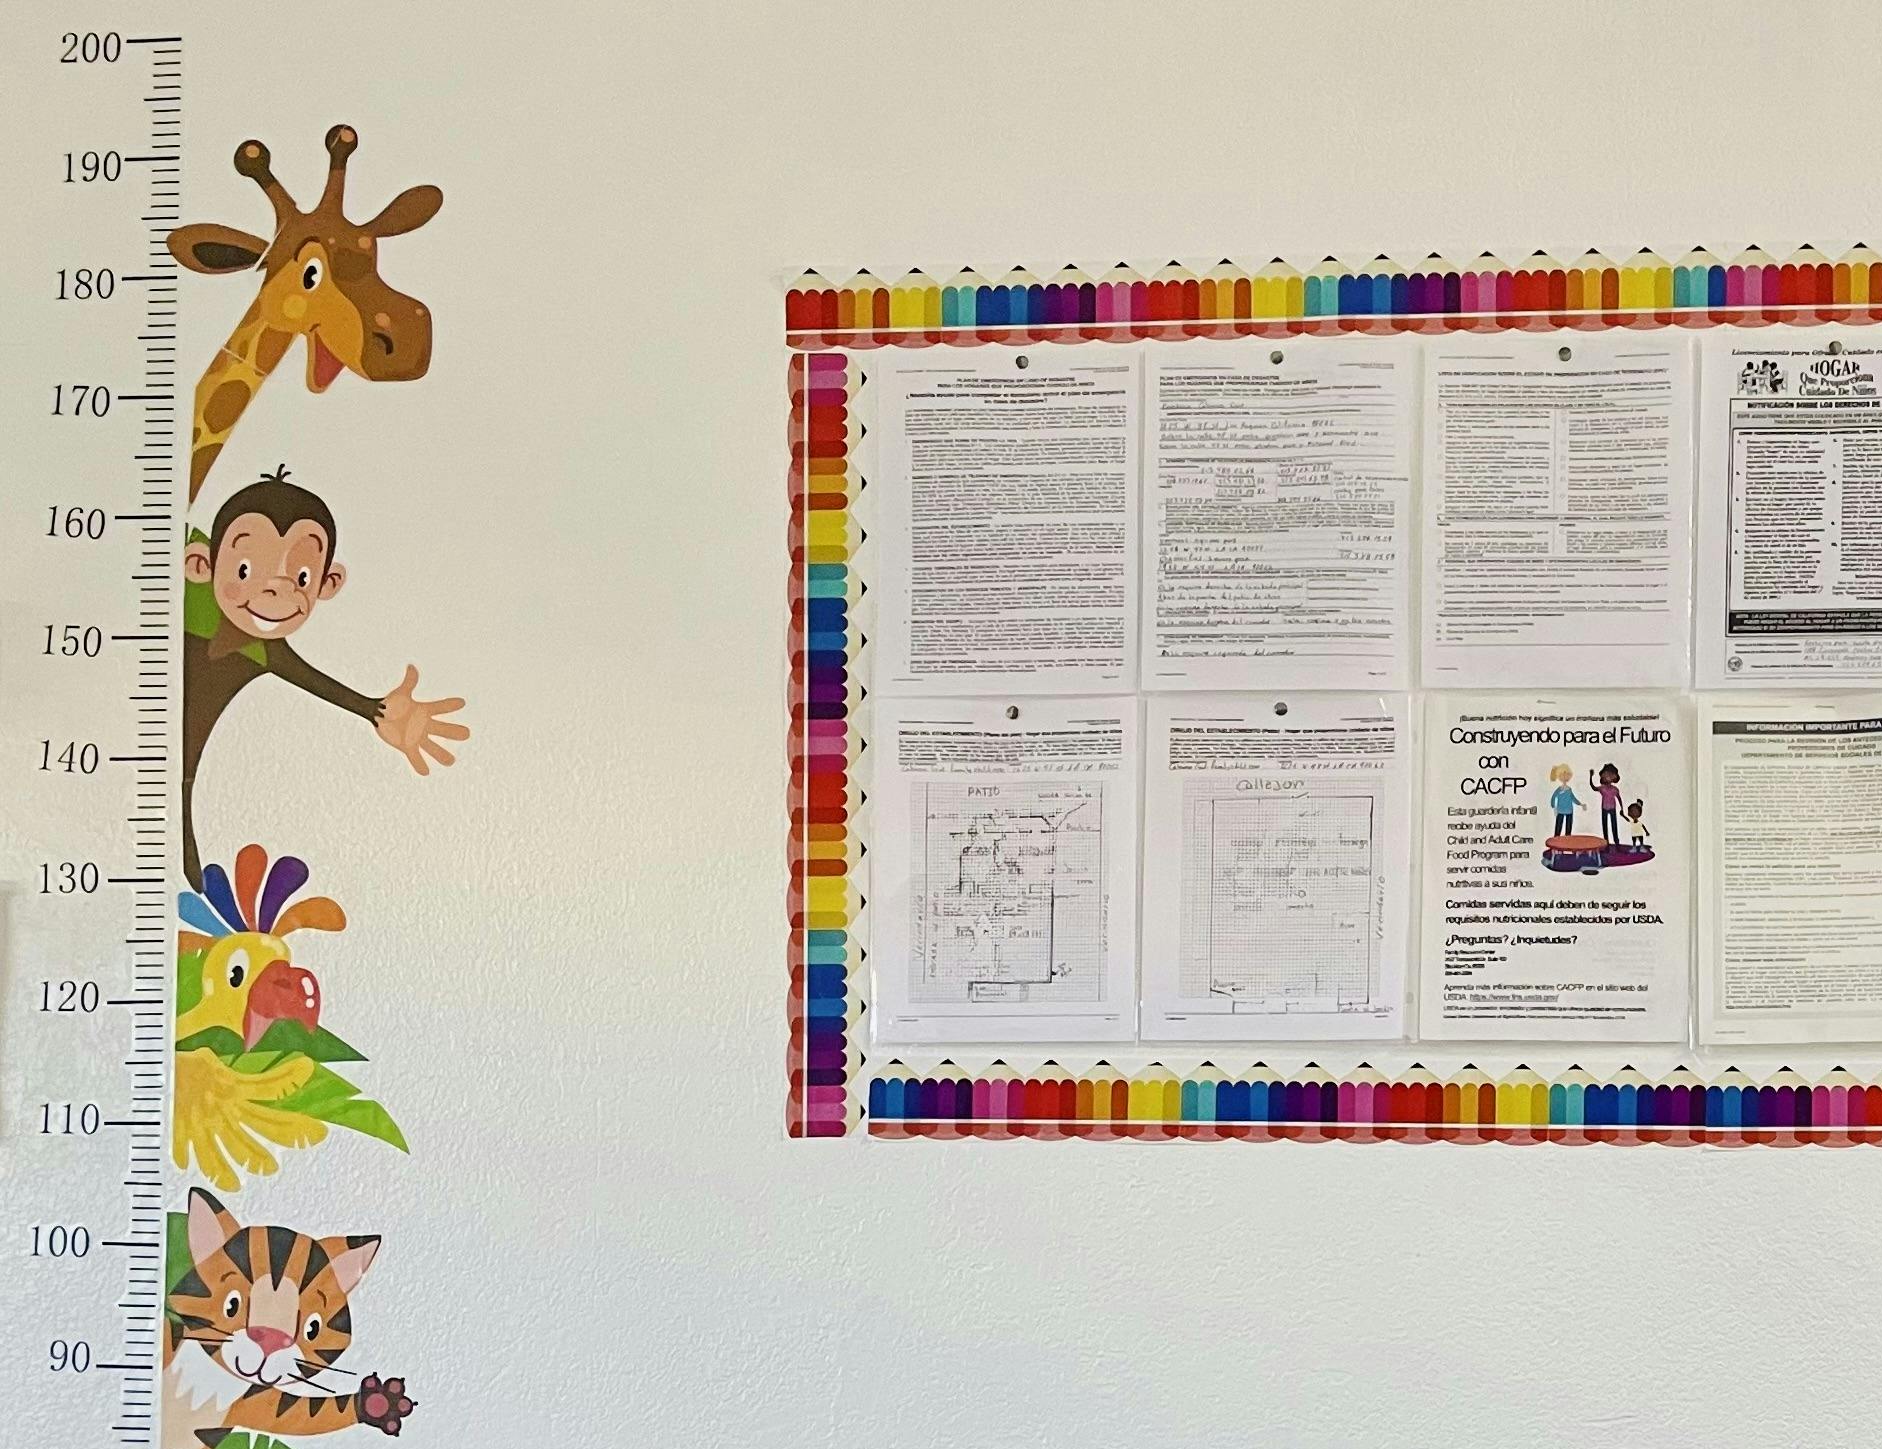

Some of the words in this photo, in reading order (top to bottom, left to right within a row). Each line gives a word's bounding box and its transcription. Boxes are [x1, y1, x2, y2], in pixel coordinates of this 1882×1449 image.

[60, 32, 121, 63] 200
[63, 151, 122, 183] 190
[56, 268, 115, 300] 180
[51, 384, 111, 417] 170
[46, 505, 106, 540] 160
[42, 624, 102, 658] 150
[1805, 721, 1858, 731] IMPORTANTE
[1860, 720, 1882, 730] PARA
[1450, 727, 1560, 747] Construyendo
[1563, 729, 1599, 747] para
[1602, 727, 1616, 743] el
[1620, 726, 1671, 744] Futuro
[38, 739, 99, 774] 140
[1479, 755, 1509, 769] con
[967, 786, 1000, 797] PATIO
[1460, 777, 1528, 795] CACFP
[1448, 807, 1467, 816] Esta
[1447, 822, 1473, 830] recibe
[1475, 822, 1501, 831] ayuda
[1502, 820, 1516, 830] del
[1447, 835, 1469, 845] Child
[1470, 836, 1487, 844] and
[1488, 835, 1510, 844] Adult
[1511, 835, 1534, 844] Care
[1447, 850, 1470, 859] Food
[1471, 850, 1508, 860] Program
[1509, 851, 1530, 860] para
[39, 861, 99, 894] 130
[1447, 866, 1469, 874] servir
[1471, 865, 1507, 873] comidas
[1445, 900, 1487, 909] Comidas
[1489, 899, 1532, 909] servidas
[1534, 899, 1554, 911] aquí
[1556, 899, 1586, 910] deben
[1588, 900, 1599, 909] de
[1601, 900, 1631, 911] seguir
[1633, 901, 1647, 910] los
[1445, 916, 1490, 926] requisitos
[1493, 915, 1552, 924] nutricionales
[1554, 915, 1613, 925] establecidos
[1615, 916, 1631, 926] por
[1633, 915, 1664, 924] USDA.
[1445, 935, 1508, 946] ¿Preguntas?
[1510, 935, 1578, 946] ¿Inquietudes?
[1556, 983, 1584, 991] CACFP
[39, 981, 99, 1013] 120
[40, 1103, 100, 1135] 110
[31, 1225, 90, 1258] 100
[50, 1340, 91, 1373] 90
